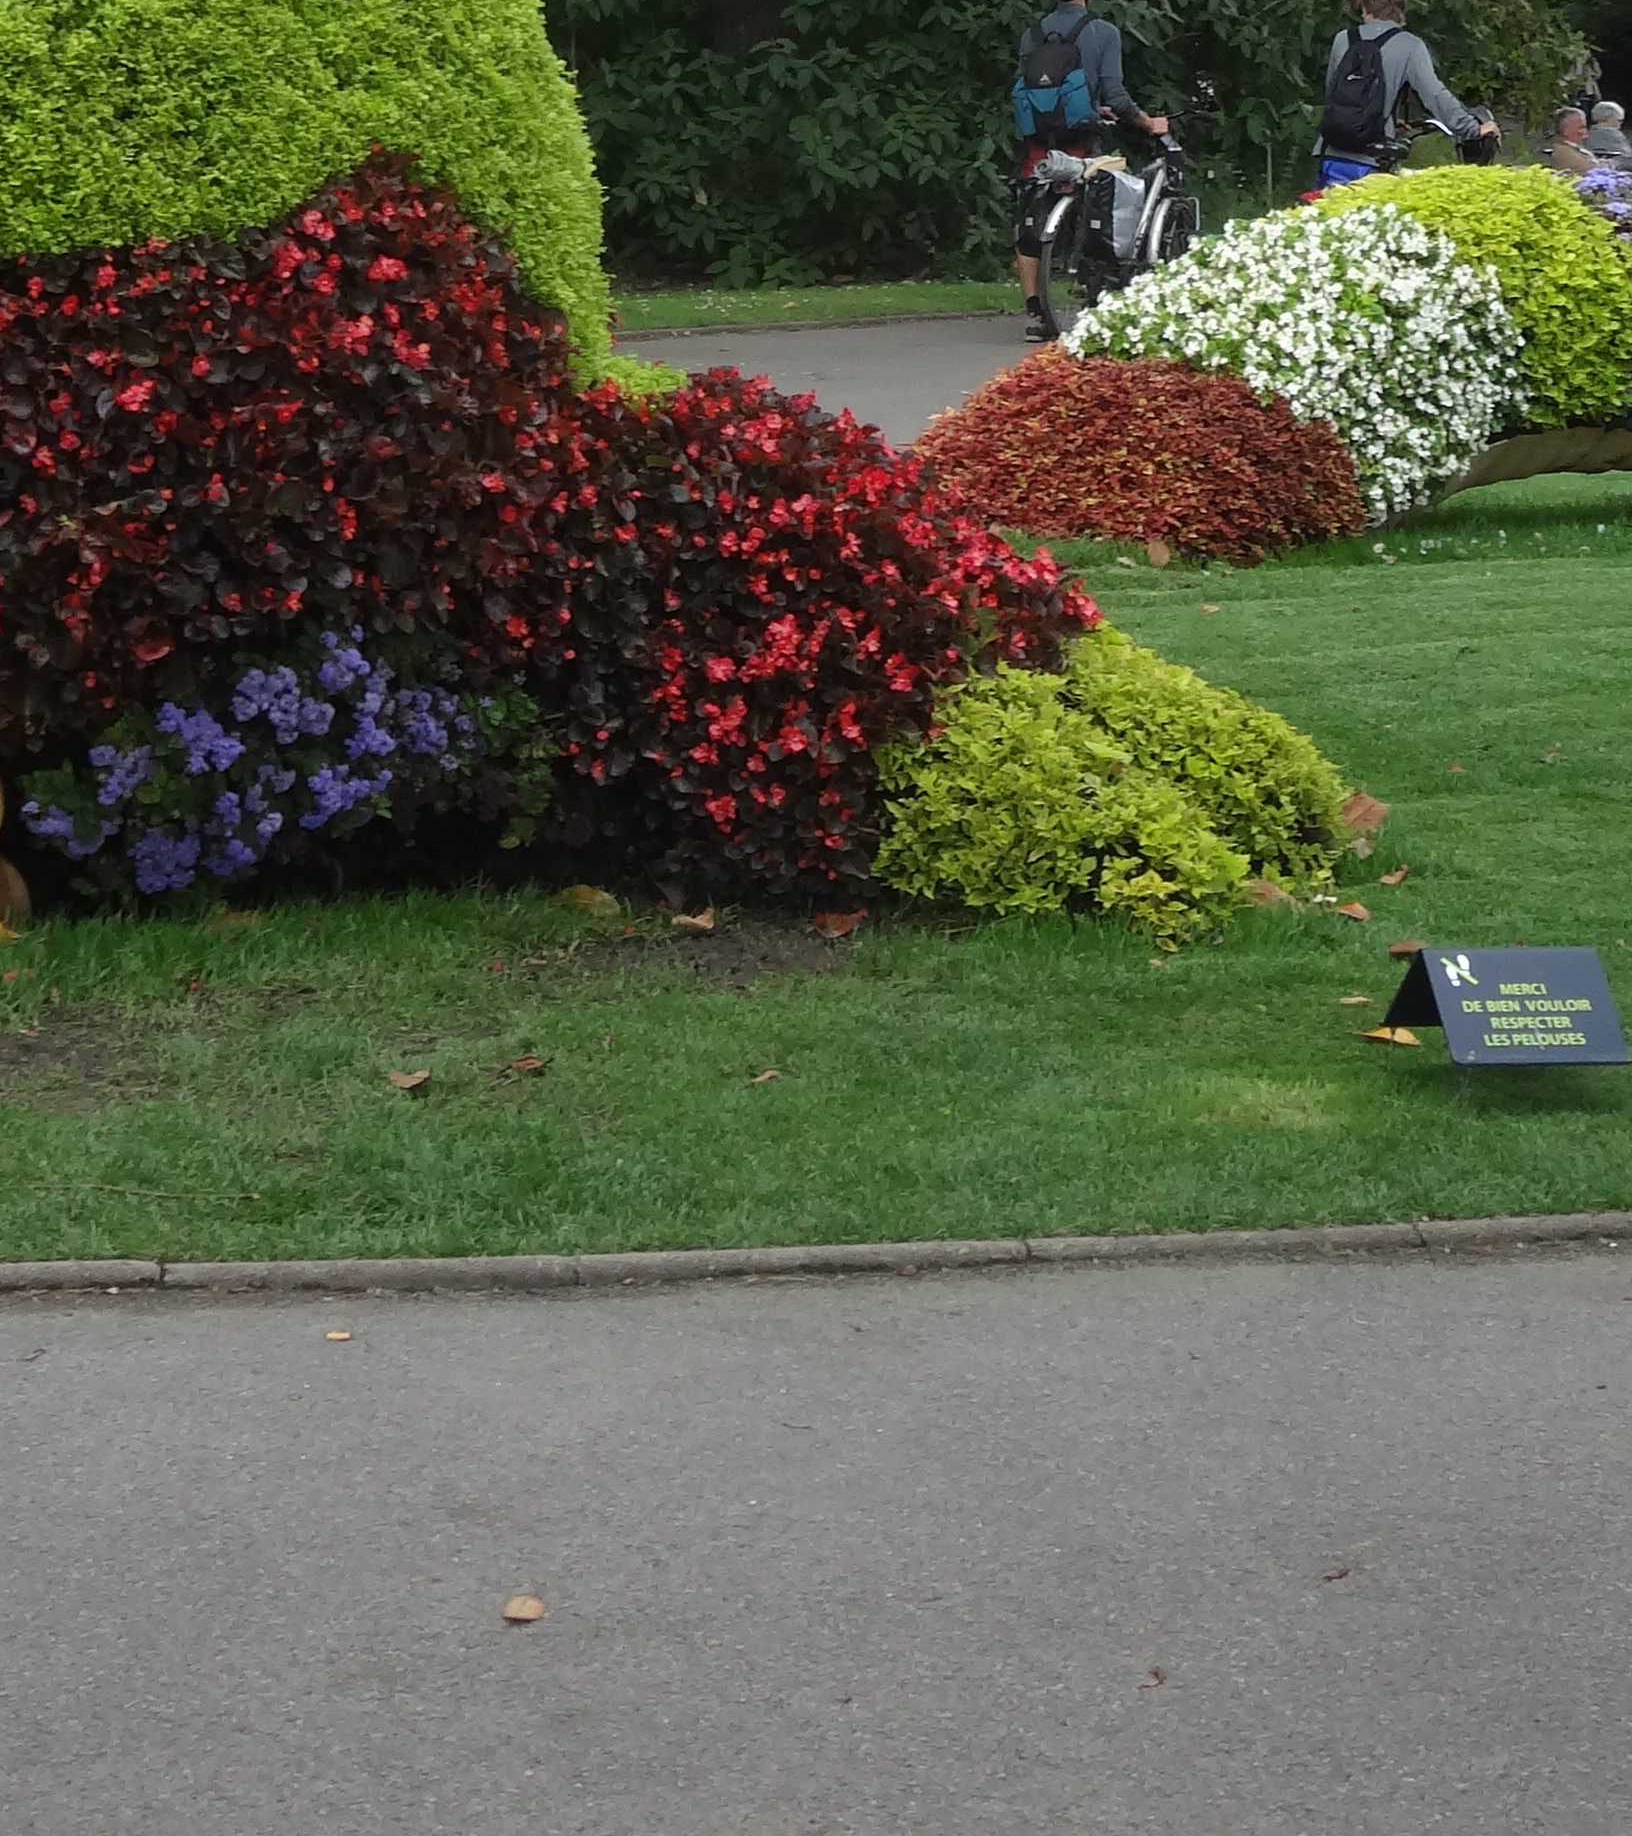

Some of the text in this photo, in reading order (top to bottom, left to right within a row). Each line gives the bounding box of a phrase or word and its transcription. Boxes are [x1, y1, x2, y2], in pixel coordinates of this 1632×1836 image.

[1500, 983, 1547, 995] MERCI
[1461, 999, 1592, 1013] DE BIEN VOULOIR
[1490, 1017, 1572, 1029] RESPECTER
[1483, 1033, 1587, 1046] LES PELOUSES
